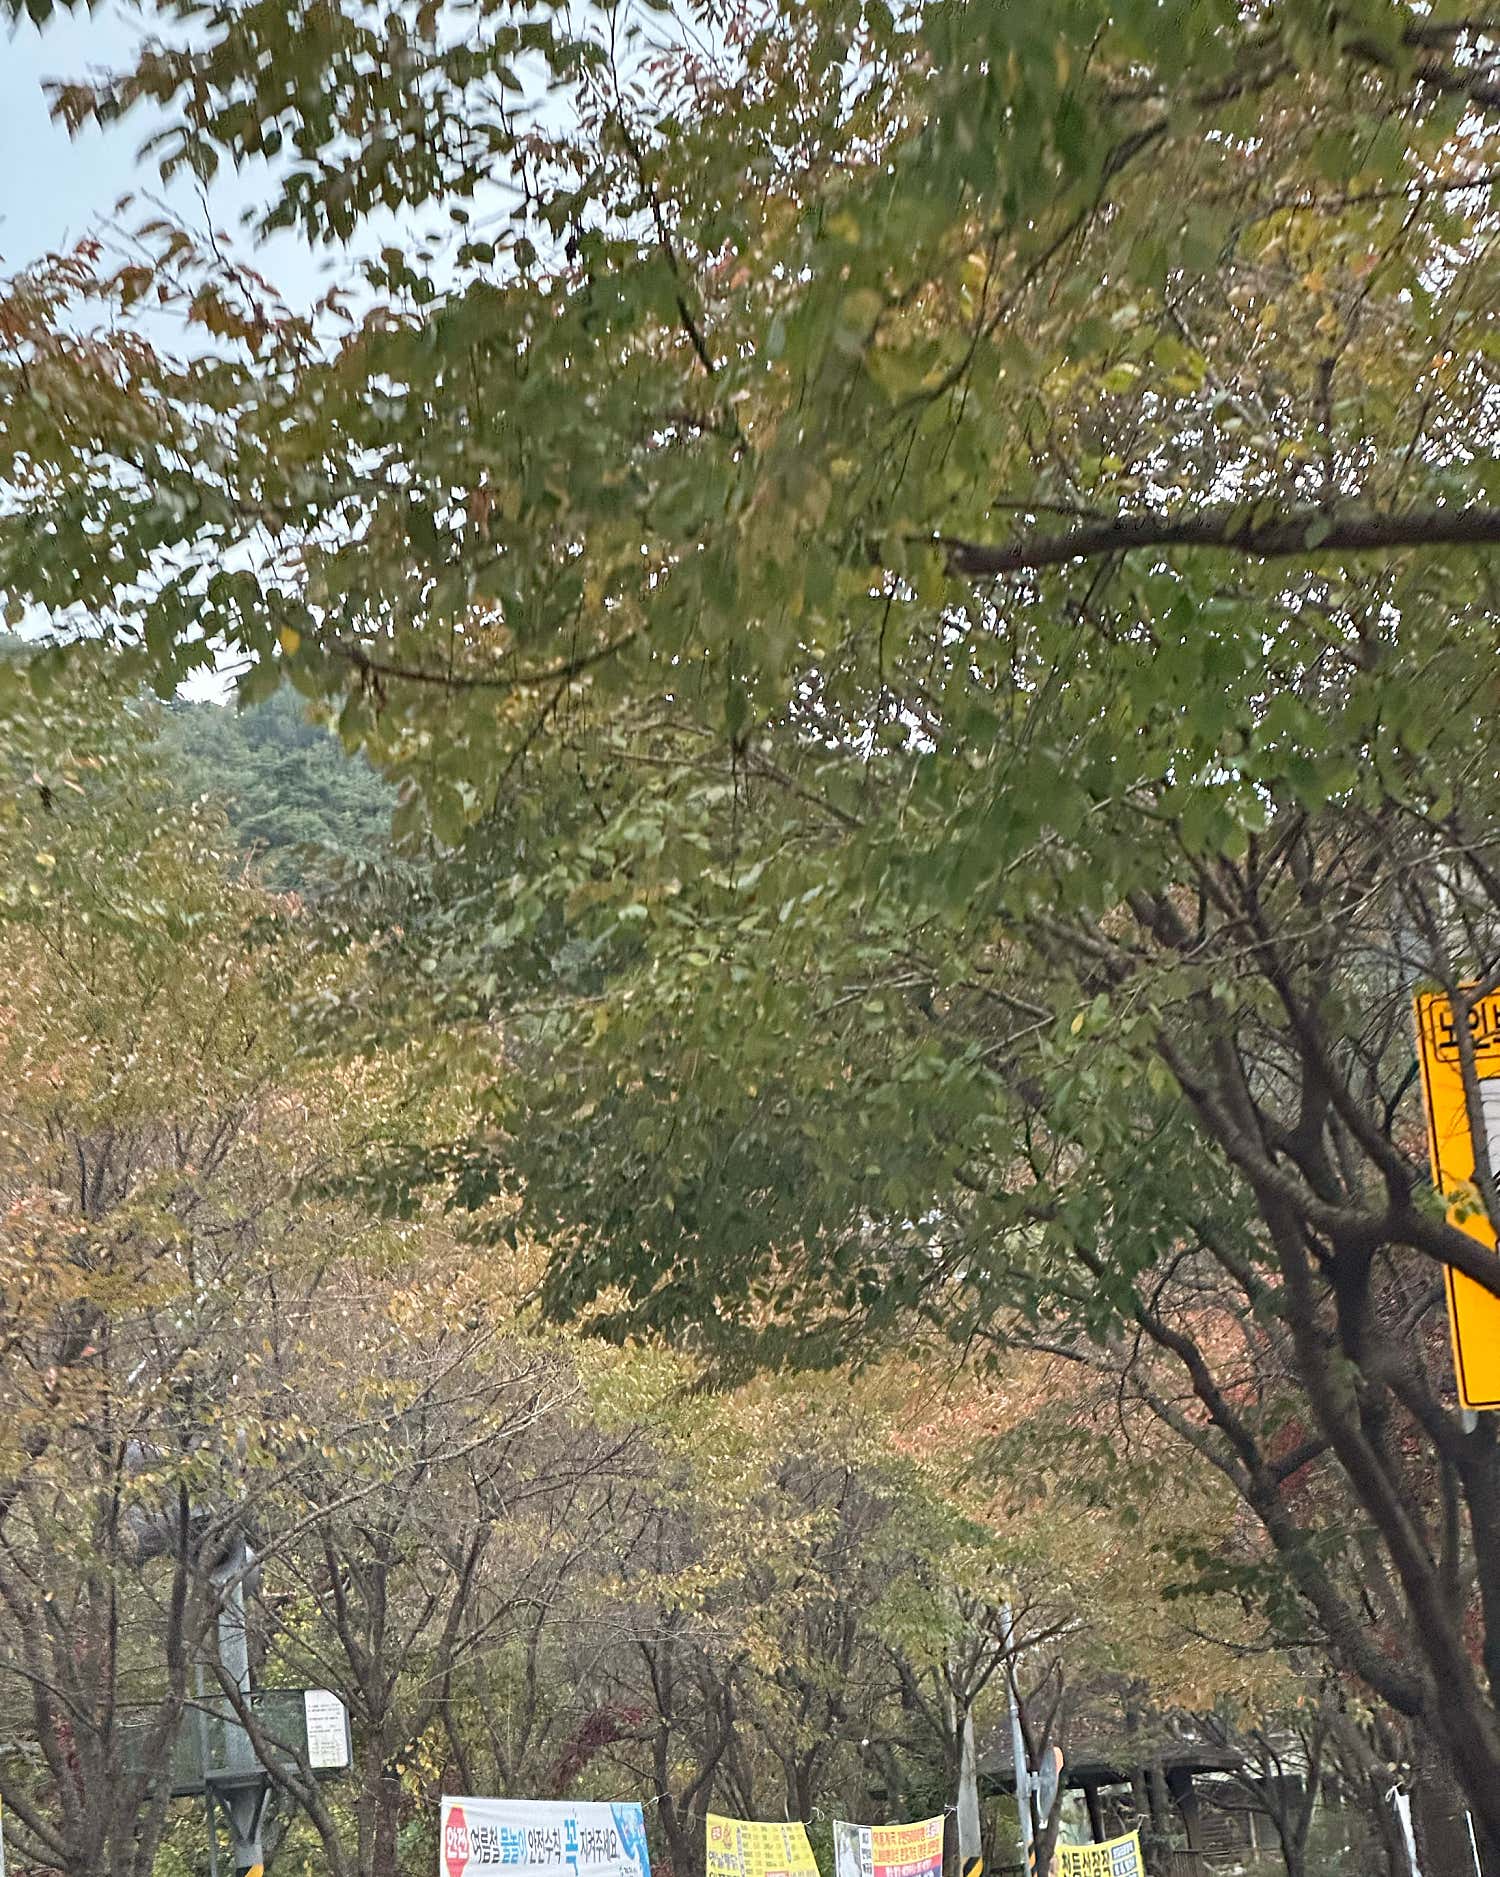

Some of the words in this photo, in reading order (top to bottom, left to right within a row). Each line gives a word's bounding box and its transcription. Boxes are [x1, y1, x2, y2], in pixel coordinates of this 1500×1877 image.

[446, 1826, 469, 1859] 안전
[470, 1825, 500, 1864] 여름철
[500, 1826, 528, 1864] 물놀이
[527, 1826, 561, 1864] 안전수칙
[564, 1818, 578, 1876] 꼭
[579, 1827, 619, 1863] 지켜주세요
